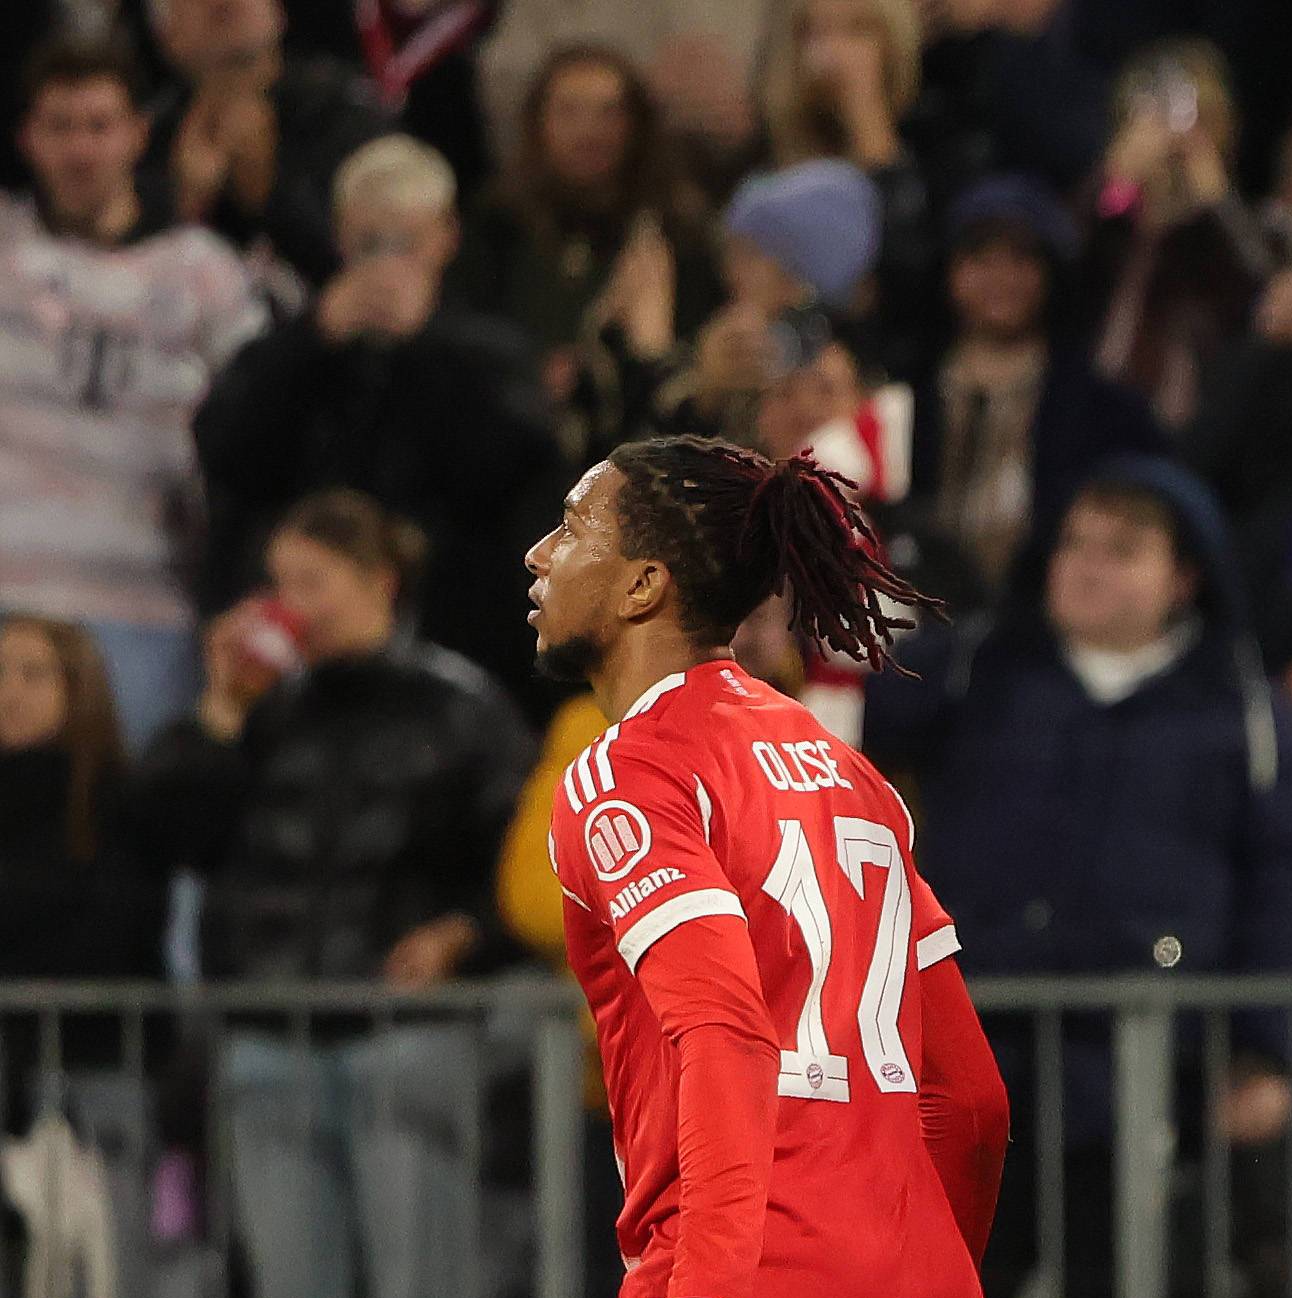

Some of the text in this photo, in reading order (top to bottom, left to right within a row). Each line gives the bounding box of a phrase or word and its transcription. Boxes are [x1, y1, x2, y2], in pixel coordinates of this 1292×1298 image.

[752, 739, 853, 793] OLISE
[608, 867, 688, 921] Allianz
[761, 816, 917, 1102] 17
